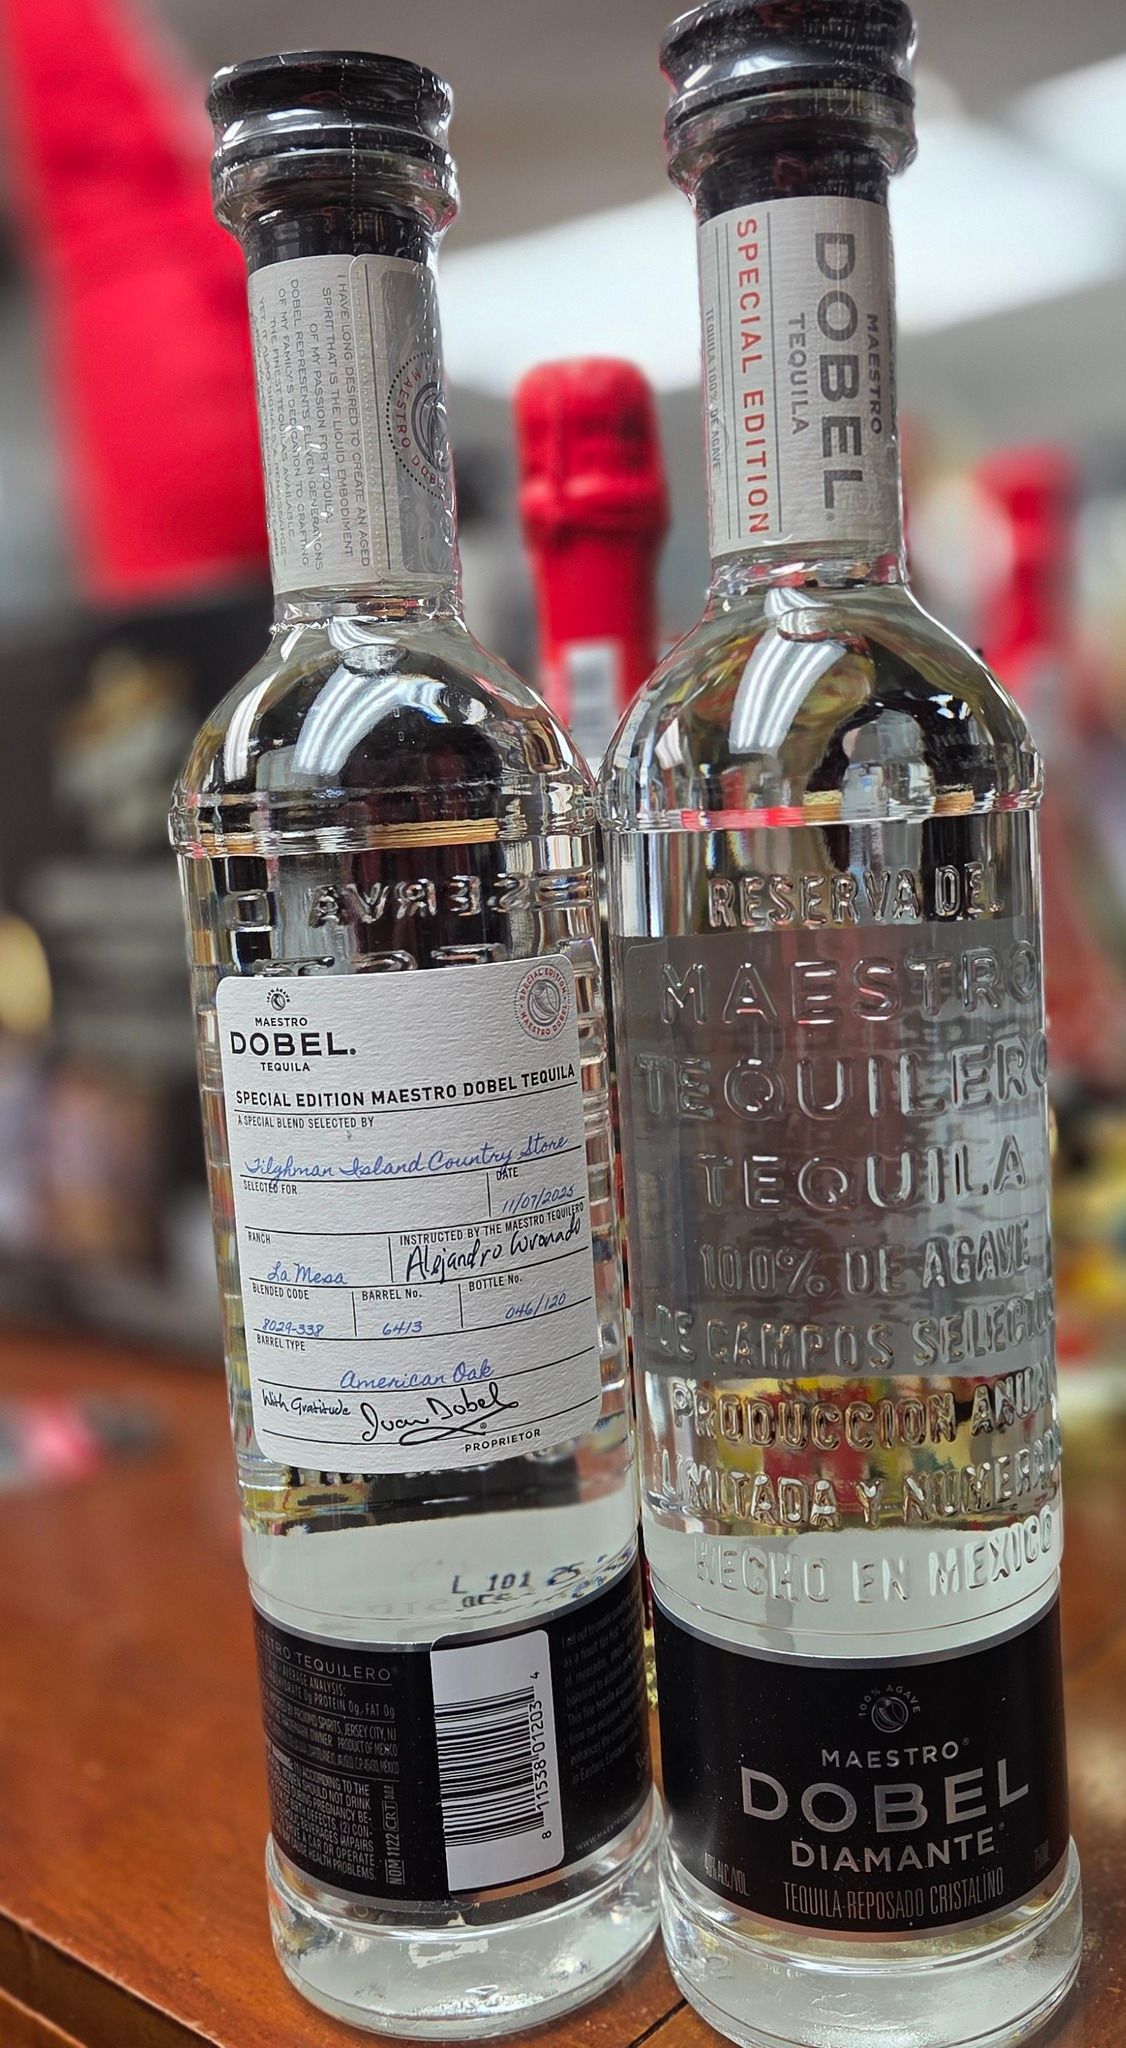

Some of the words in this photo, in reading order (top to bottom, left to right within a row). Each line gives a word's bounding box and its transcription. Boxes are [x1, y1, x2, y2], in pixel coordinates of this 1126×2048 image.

[277, 287, 288, 306] OF
[289, 278, 303, 327] DOBEL
[321, 287, 335, 329] SPIRIT
[338, 283, 350, 320] HAVE
[736, 218, 763, 373] SPECIAL
[279, 312, 289, 330] MY
[309, 323, 319, 342] OF
[704, 307, 717, 363] TEQUILA
[311, 347, 322, 365] MY
[326, 334, 338, 367] THAT
[341, 324, 354, 361] LONG
[281, 336, 295, 394] FAMILY'S
[294, 331, 311, 419] REPRESENTS
[328, 371, 339, 385] IS
[787, 312, 809, 435] TEQUILA
[867, 313, 882, 435] MAESTRO
[313, 370, 327, 428] PASSION
[330, 391, 342, 415] THE
[344, 367, 359, 426] DESIRED
[710, 408, 719, 424] DE
[318, 434, 329, 461] FOR
[332, 420, 345, 464] LIQUID
[350, 430, 361, 448] TO
[711, 430, 722, 472] AGAVE
[351, 452, 366, 502] CREATE
[743, 390, 770, 533] EDITION
[295, 481, 304, 498] TO
[307, 480, 324, 571] GENERATIONS
[337, 468, 354, 557] EMBODIMENT
[357, 507, 368, 526] AN
[297, 503, 310, 566] CRAFTING
[359, 530, 371, 567] AGED
[706, 869, 922, 929] RESERVA
[520, 968, 544, 1001] SPECIAL
[544, 965, 567, 994] EDITION
[661, 938, 1038, 1027] MAESTRO
[254, 1017, 308, 1027] MAESTRO
[521, 1011, 551, 1036] MAESTRO
[552, 1004, 568, 1032] DOBEL
[260, 1062, 311, 1072] TEQUILA
[637, 1030, 1048, 1122] TEQUILERO
[236, 1090, 291, 1107] SPECIAL
[296, 1092, 365, 1107] EDITION
[372, 1085, 457, 1105] MAESTRO
[463, 1076, 518, 1097] DOBEL
[521, 1063, 575, 1088] TEQUILA
[237, 1115, 243, 1126] A
[244, 1116, 275, 1128] SPECIAL
[277, 1117, 304, 1129] BLEND
[308, 1117, 357, 1129] SELECTED
[361, 1116, 374, 1128] BY
[244, 1155, 334, 1188] Tilghman
[339, 1152, 425, 1178] Island
[428, 1142, 513, 1175] Country
[518, 1132, 569, 1160] Store
[496, 1167, 519, 1181] DATE
[700, 1133, 1027, 1212] TEQUILA
[243, 1181, 279, 1194] SELECTED
[281, 1185, 298, 1195] FOR
[502, 1184, 575, 1214] 11/07/2025
[247, 1231, 271, 1245] RANCH
[400, 1229, 468, 1246] INSTRUCTED
[467, 1227, 481, 1238] BY
[484, 1224, 502, 1236] THE
[505, 1213, 545, 1233] MAESTRO
[547, 1202, 584, 1223] TEQUILERO
[267, 1261, 290, 1282] La
[294, 1262, 348, 1285] Mesa
[406, 1238, 502, 1284] Alejandro
[701, 1244, 829, 1297] 100%
[845, 1243, 908, 1297] DE
[922, 1219, 1031, 1290] AGAVE
[252, 1282, 284, 1298] BLENDED
[286, 1289, 309, 1300] CODE
[362, 1289, 402, 1301] BARREL
[405, 1288, 422, 1299] No.
[469, 1276, 504, 1292] BOTTLE
[508, 1273, 523, 1285] No.
[505, 1293, 567, 1320] 046/120
[256, 1333, 284, 1349] BARREL
[286, 1338, 306, 1351] TYPE
[262, 1318, 325, 1338] 8029-338
[382, 1321, 423, 1336] 6413
[655, 1302, 697, 1363] DE
[706, 1318, 896, 1371] CAMPOS
[340, 1370, 445, 1389] American
[453, 1358, 495, 1383] Oak
[262, 1389, 290, 1413] With
[291, 1397, 351, 1416] Gratitude
[360, 1402, 430, 1442] Juan
[426, 1381, 519, 1420] Dobel
[465, 1428, 542, 1453] PROPRIETOR
[856, 1478, 886, 1528] Y
[694, 1535, 830, 1603] HECHO
[852, 1557, 910, 1603] EN
[928, 1505, 1054, 1597] MEXICO
[488, 1571, 531, 1592] 101
[295, 1652, 391, 1682] TEQUILERO
[530, 1671, 540, 1680] 4
[314, 1693, 346, 1712] PROTEIN
[366, 1703, 380, 1716] FAT
[383, 1704, 396, 1720] 0g
[886, 1684, 920, 1713] AGAVE
[344, 1721, 368, 1739] JERSEY
[530, 1700, 545, 1754] 01203
[821, 1741, 959, 1769] MAESTRO
[329, 1791, 344, 1804] NOT
[345, 1795, 371, 1810] DRINK
[342, 1780, 353, 1793] TO
[354, 1782, 371, 1797] THE
[534, 1759, 550, 1811] 11538
[740, 1758, 1030, 1834] DOBEL
[313, 1796, 356, 1821] PREGNANCY
[384, 1803, 398, 1831] CRT
[385, 1832, 401, 1857] 1122
[542, 1830, 552, 1840] 8
[790, 1826, 996, 1874] DIAMANTE
[308, 1835, 322, 1850] CAR
[323, 1843, 335, 1856] OR
[336, 1847, 376, 1867] OPERATE
[388, 1860, 403, 1885] NOM
[929, 1866, 1004, 1914] CRISTALINO
